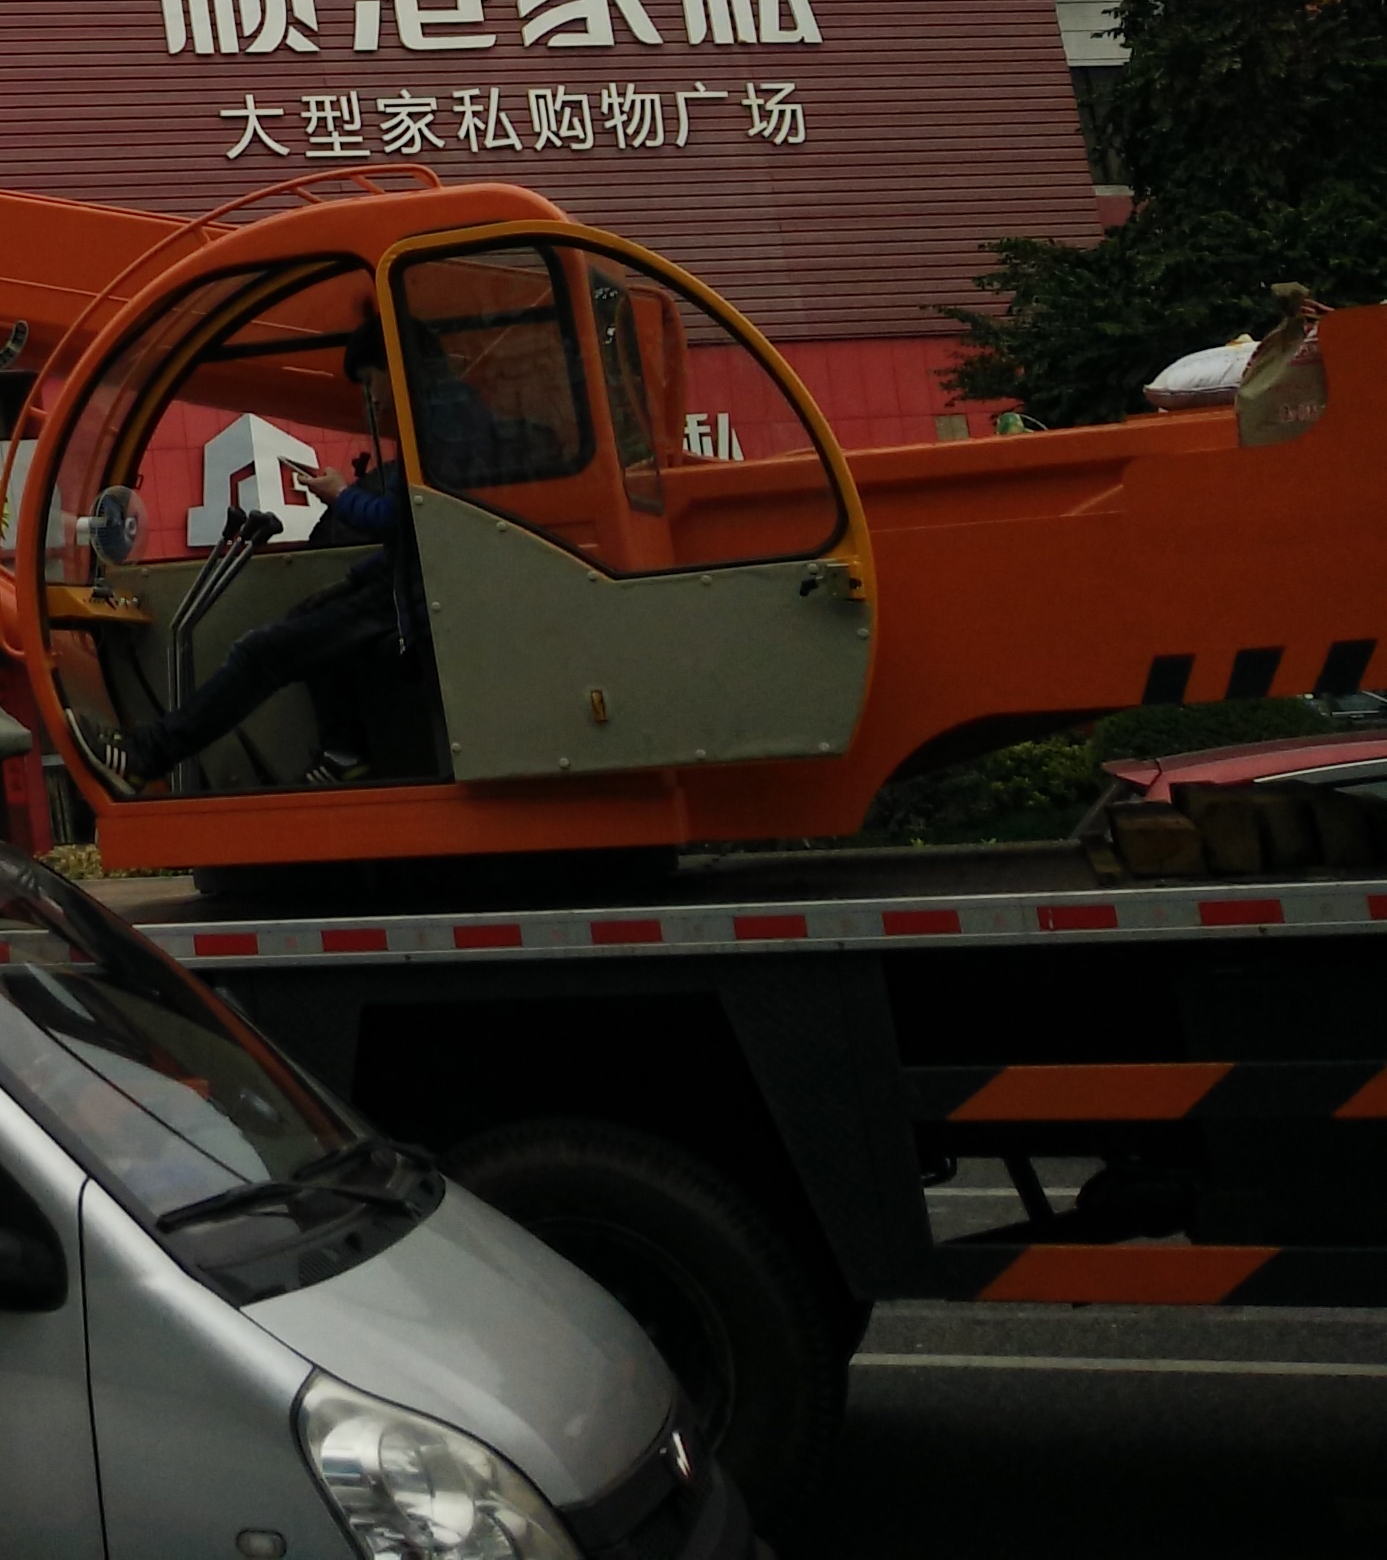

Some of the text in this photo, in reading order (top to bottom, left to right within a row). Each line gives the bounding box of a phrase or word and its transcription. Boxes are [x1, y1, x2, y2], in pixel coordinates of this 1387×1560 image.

[219, 81, 807, 159] 大型家私购物广场
